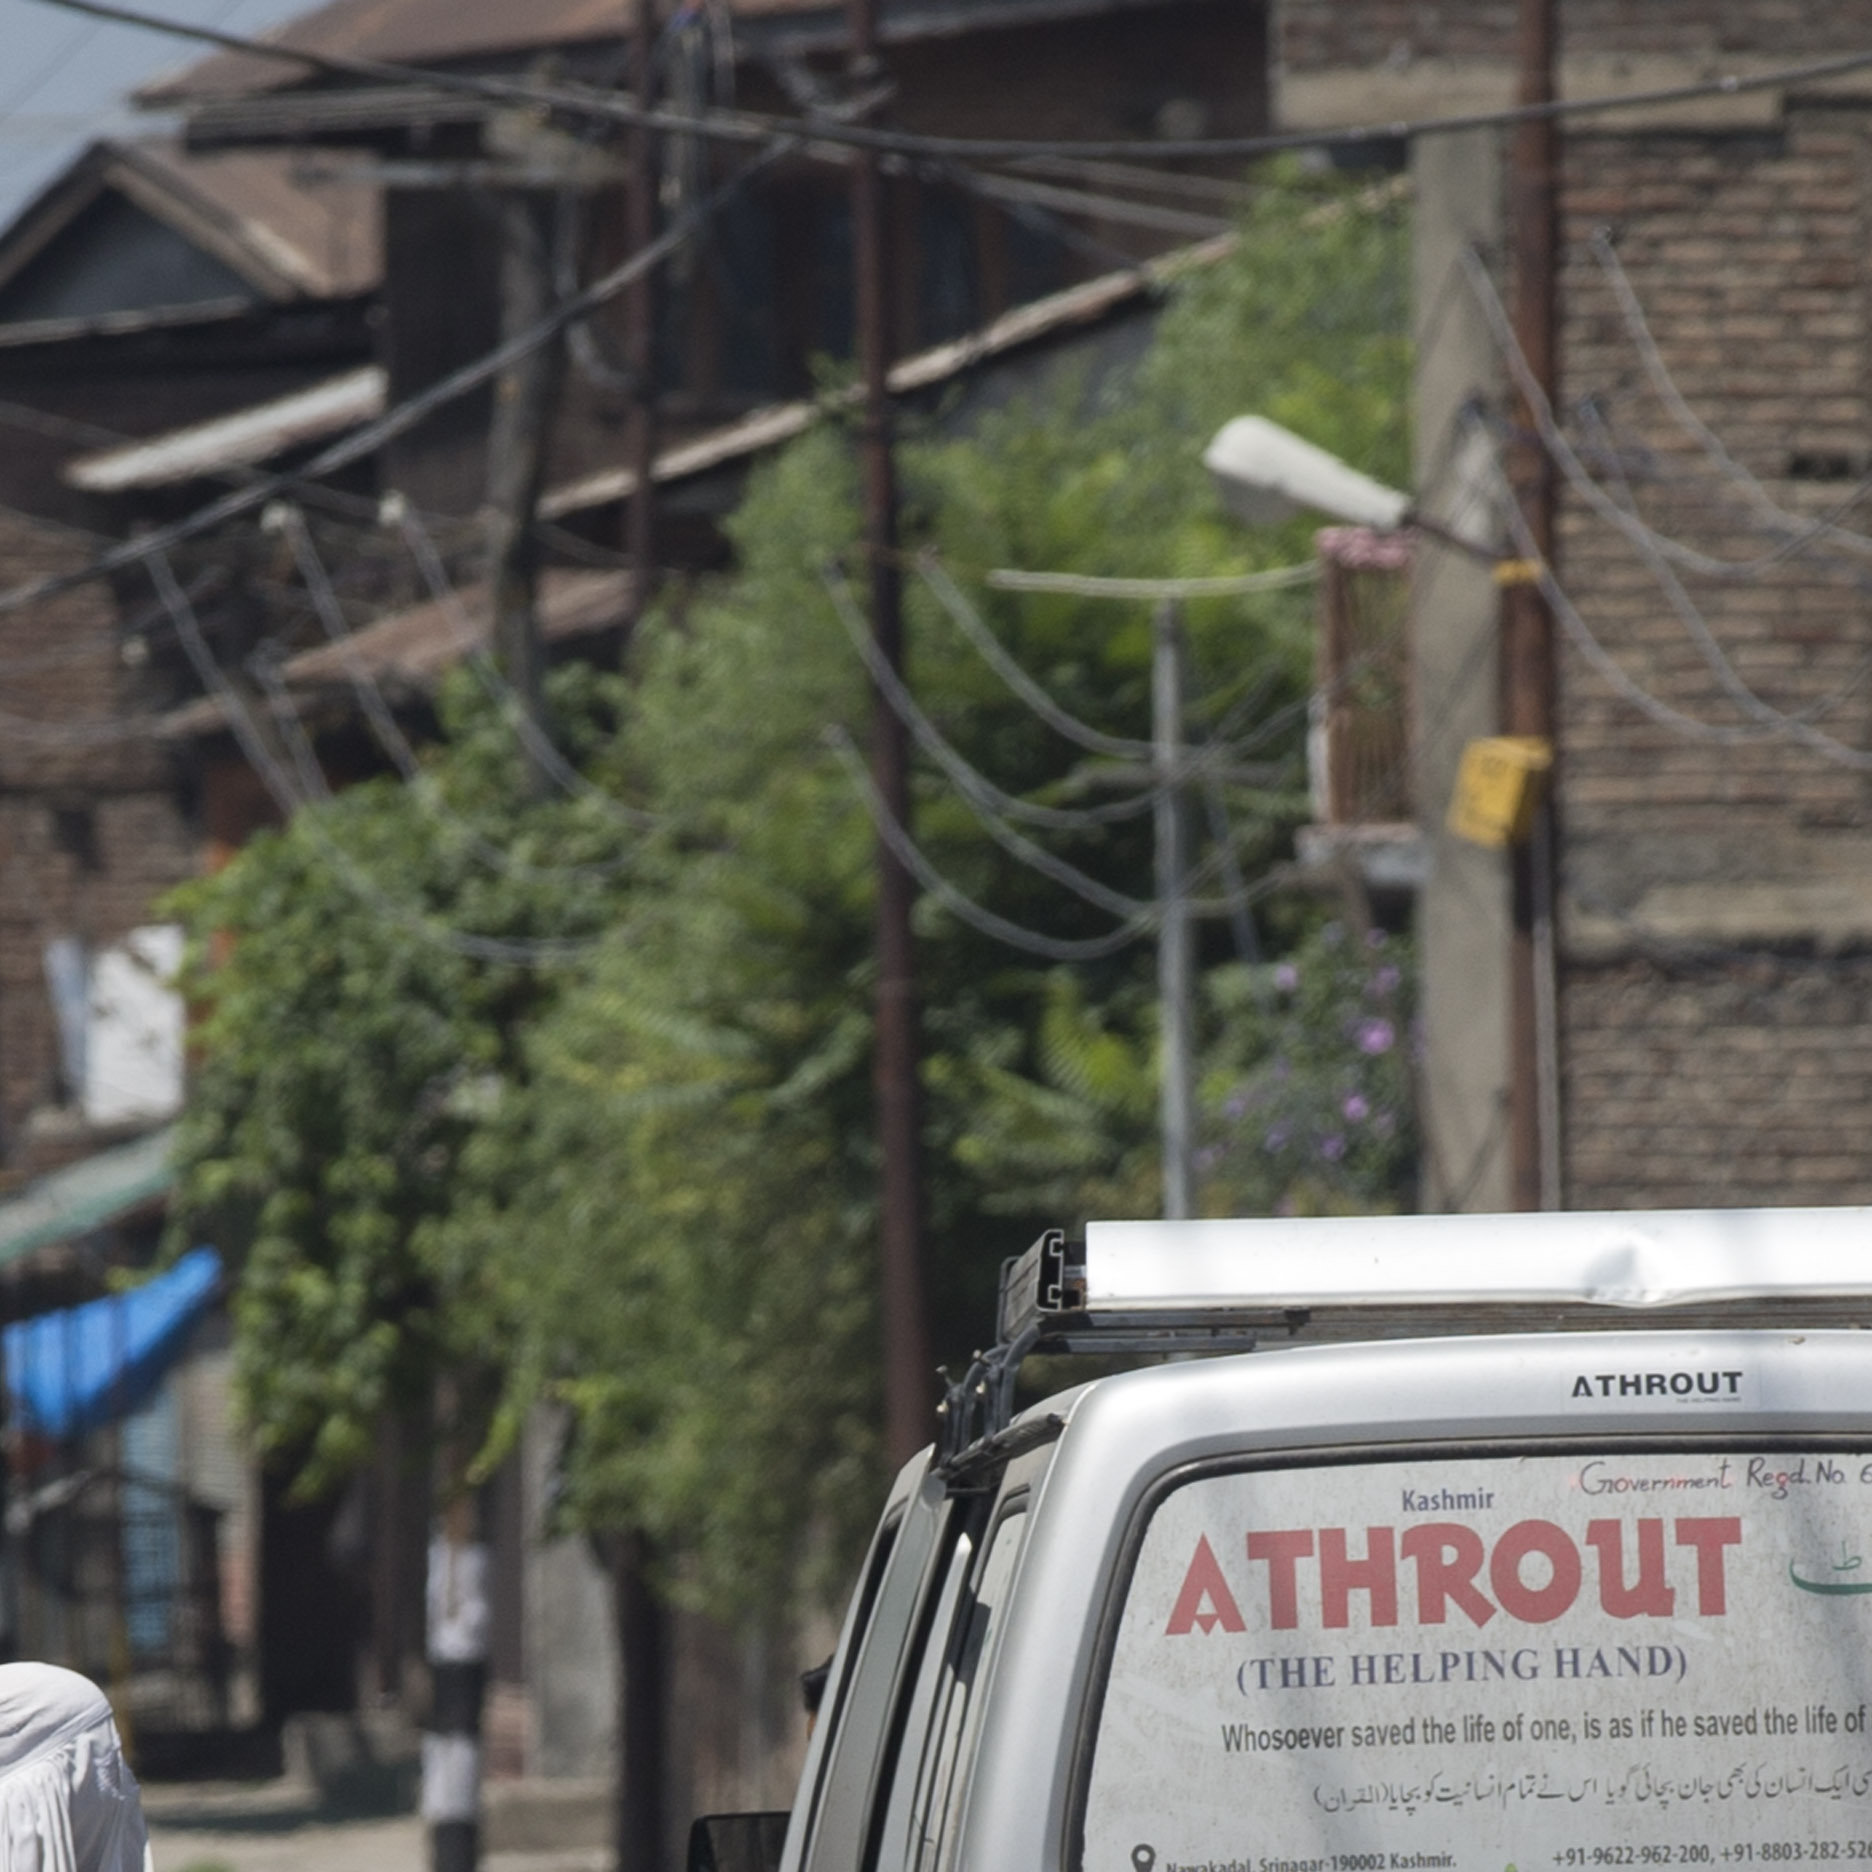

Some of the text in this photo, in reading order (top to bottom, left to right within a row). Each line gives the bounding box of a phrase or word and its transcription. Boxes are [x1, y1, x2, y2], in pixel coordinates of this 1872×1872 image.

[1572, 1372, 1742, 1397] ATHROUT
[1579, 1458, 1731, 1497] Government
[1402, 1488, 1493, 1512] Kashmir
[1164, 1517, 1741, 1635] ATHROUT
[1237, 1644, 1686, 1696] (THE HELPING HAND)
[1223, 1720, 1344, 1753] Whosoever
[1351, 1718, 1415, 1747] saved
[1422, 1715, 1456, 1744] the
[1463, 1714, 1495, 1742] life
[1503, 1714, 1524, 1741] of
[1531, 1718, 1577, 1746] one,
[1584, 1710, 1602, 1739] is
[1609, 1717, 1633, 1738] as
[1641, 1709, 1654, 1737] if
[1662, 1709, 1686, 1737] he
[1694, 1708, 1758, 1737] saved
[1764, 1706, 1799, 1735] the
[1806, 1705, 1837, 1734] life
[1845, 1705, 1867, 1733] of
[1390, 1851, 1457, 1870] Kashmir.
[1552, 1841, 1716, 1867] +91-9622-962-200,
